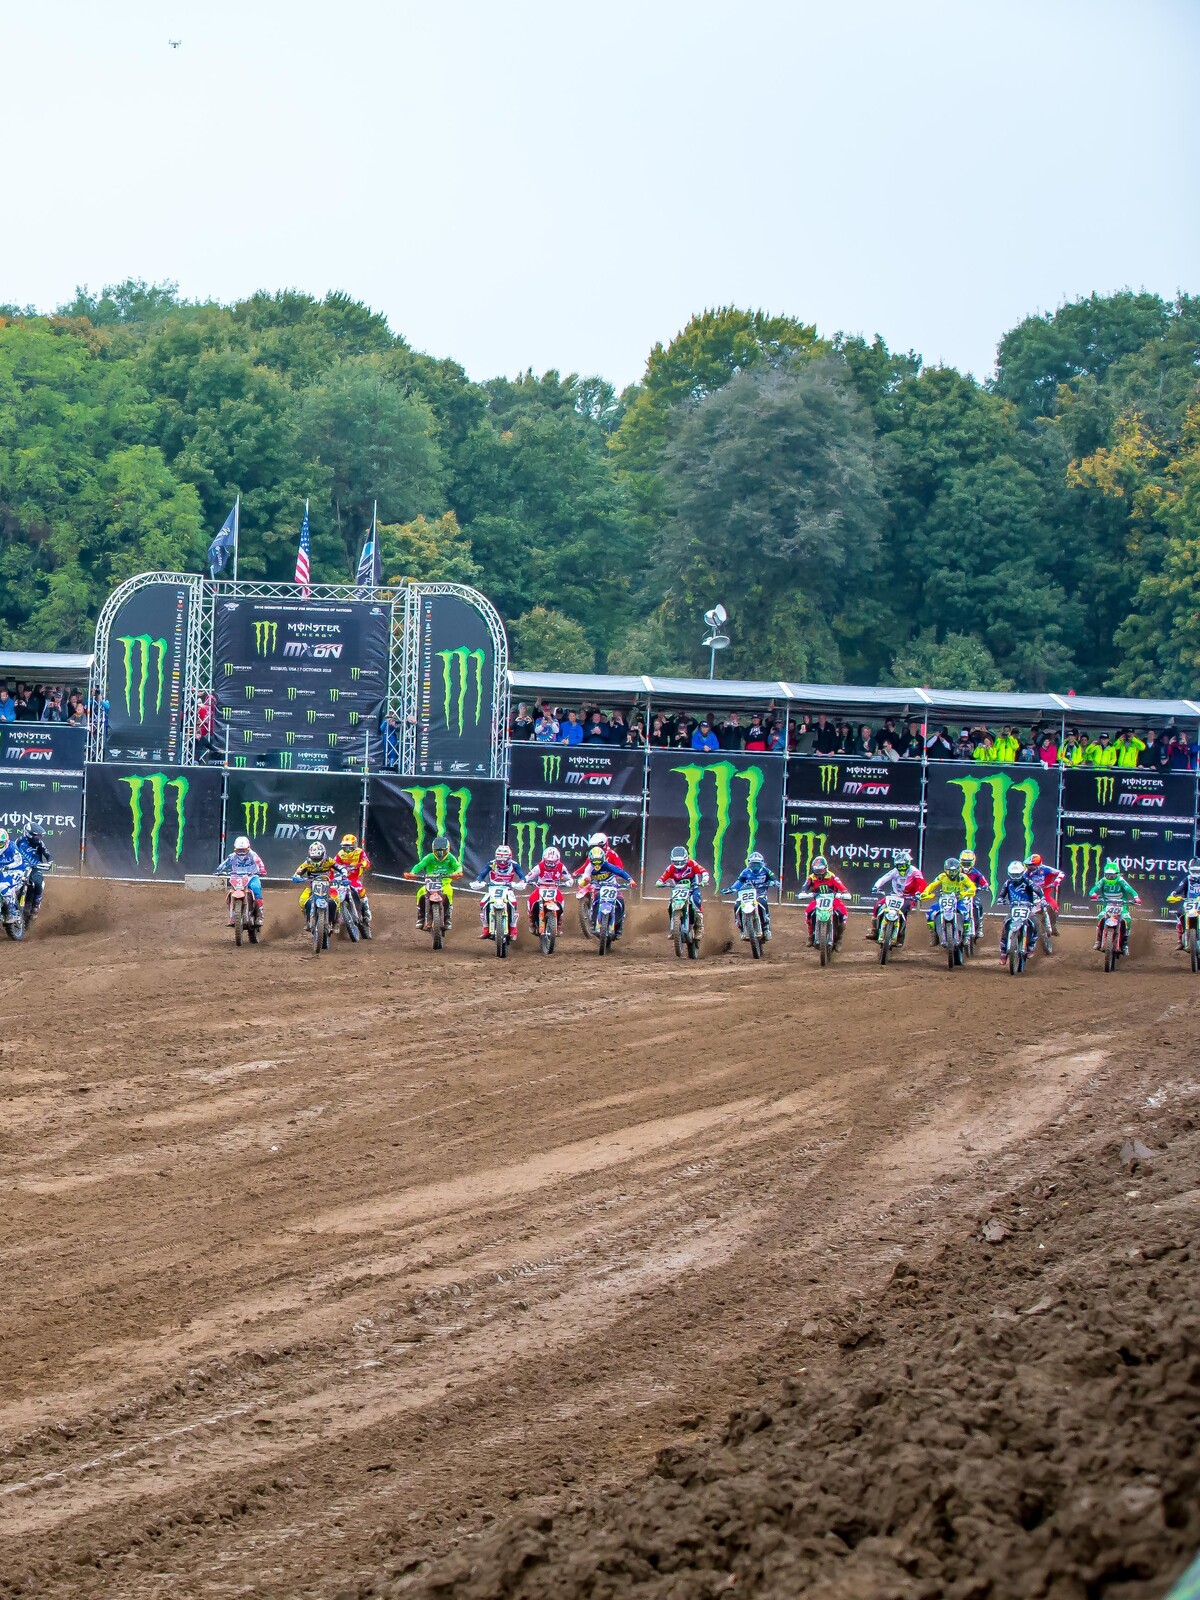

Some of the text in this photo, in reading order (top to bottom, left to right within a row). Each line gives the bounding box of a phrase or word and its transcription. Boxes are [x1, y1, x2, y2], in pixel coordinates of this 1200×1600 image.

[288, 622, 340, 633] MONSTER
[9, 732, 51, 740] MONSTER
[569, 756, 611, 765] MONSTER
[846, 766, 888, 774] MONSTER
[1122, 778, 1164, 786] MONSTER
[279, 803, 335, 814] MONSTER
[552, 834, 630, 848] MONER
[830, 844, 913, 860] MONSTER
[1106, 856, 1188, 873] MONSTER
[494, 888, 503, 897] 9
[542, 889, 556, 898] 13
[601, 889, 616, 898] 28
[819, 899, 831, 907] 10
[888, 900, 902, 908] 126
[1014, 909, 1028, 917] 63
